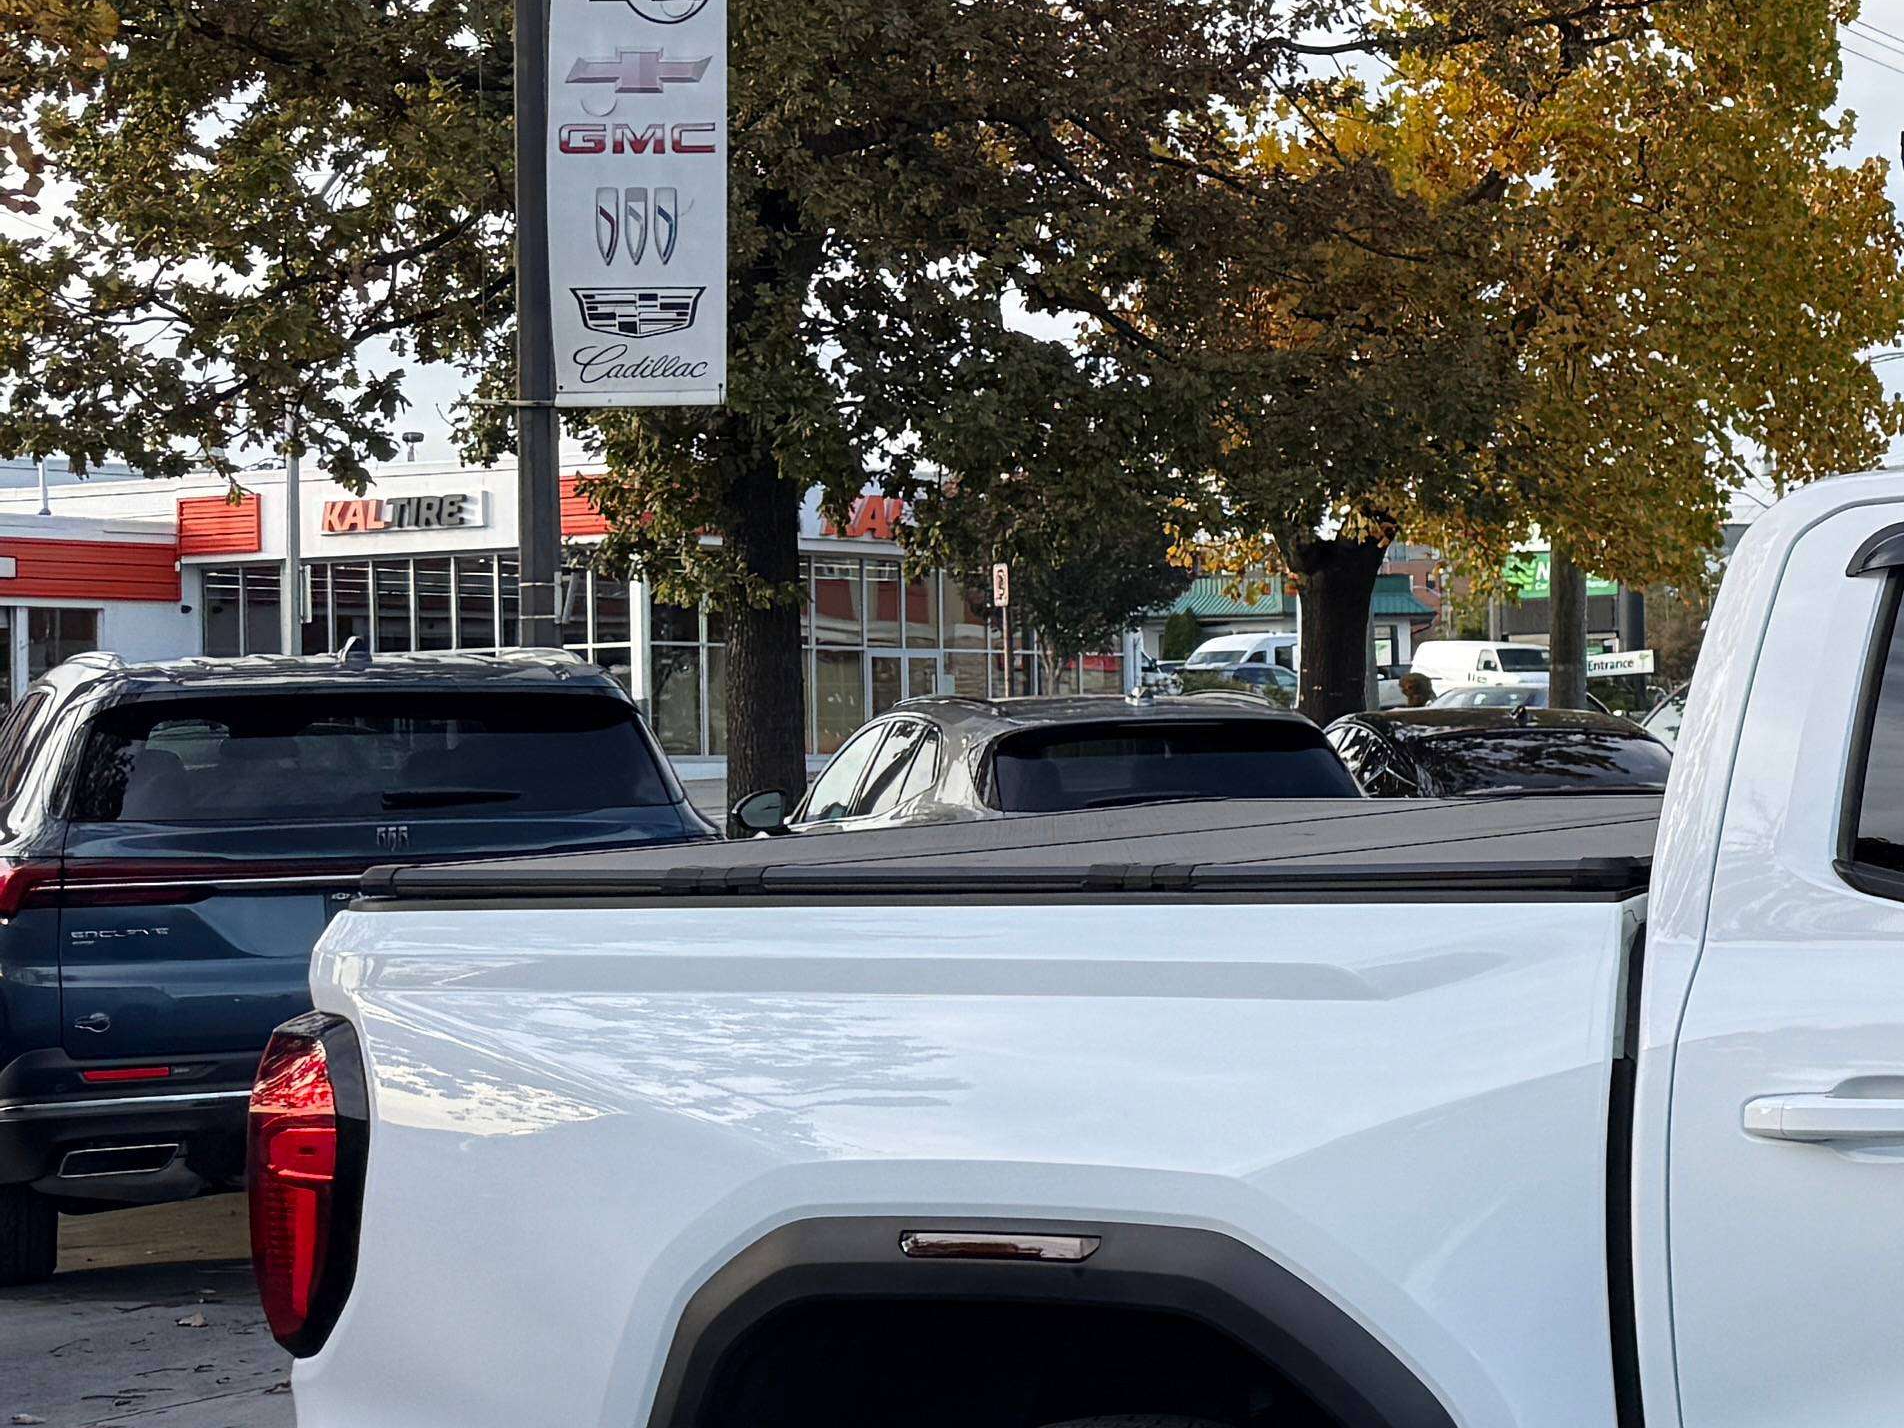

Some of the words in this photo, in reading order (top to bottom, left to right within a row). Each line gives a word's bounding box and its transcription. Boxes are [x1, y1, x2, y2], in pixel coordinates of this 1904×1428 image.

[558, 123, 717, 155] GMC
[573, 343, 708, 384] Cadillac
[322, 499, 385, 533] KAL
[387, 494, 467, 529] TIRE
[1588, 658, 1635, 672] Entrance
